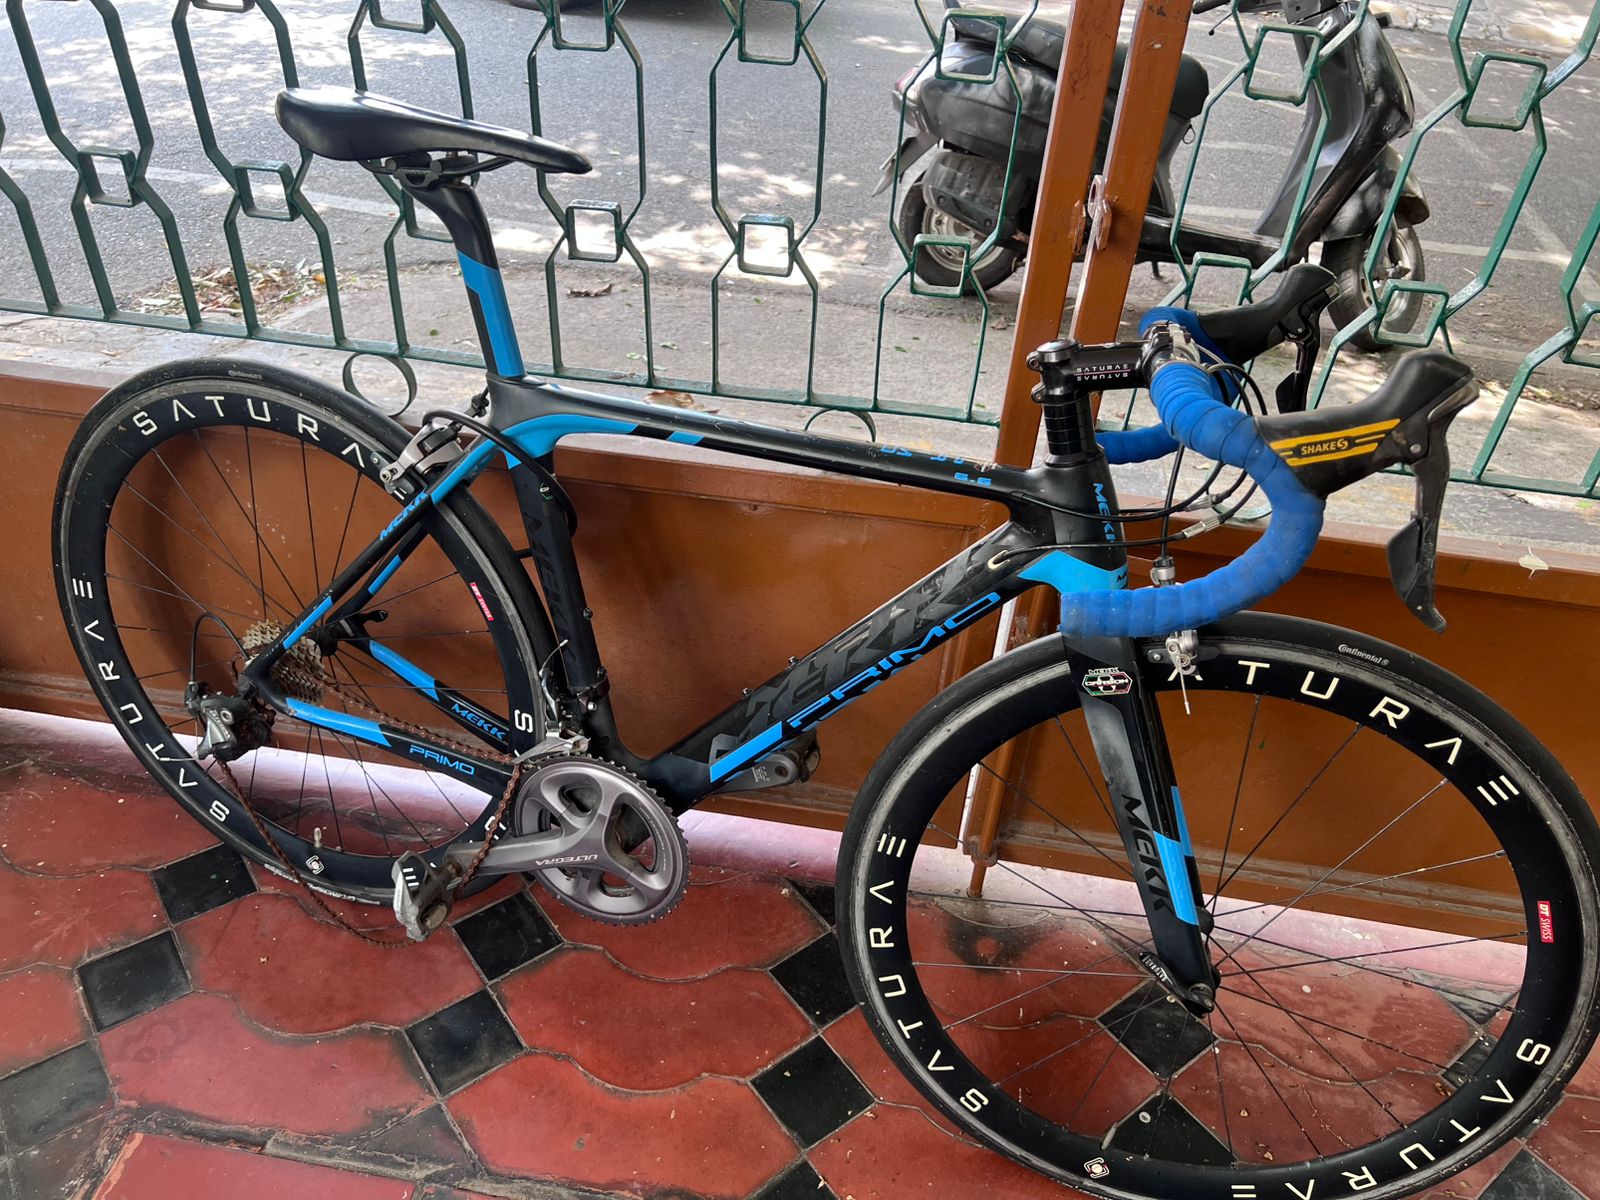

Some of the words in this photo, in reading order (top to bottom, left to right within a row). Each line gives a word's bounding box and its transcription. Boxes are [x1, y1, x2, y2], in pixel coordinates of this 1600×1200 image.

[1077, 363, 1128, 373] SATURAE
[787, 591, 1001, 728] PRIMO
[1338, 644, 1382, 664] Continental
[72, 578, 230, 823] SATURAE
[451, 703, 506, 740] MEKK
[410, 744, 475, 776] PRIMO
[536, 854, 598, 866] ULTEGRA
[1121, 794, 1175, 916] MEKK
[869, 833, 989, 1113] SATURAE
